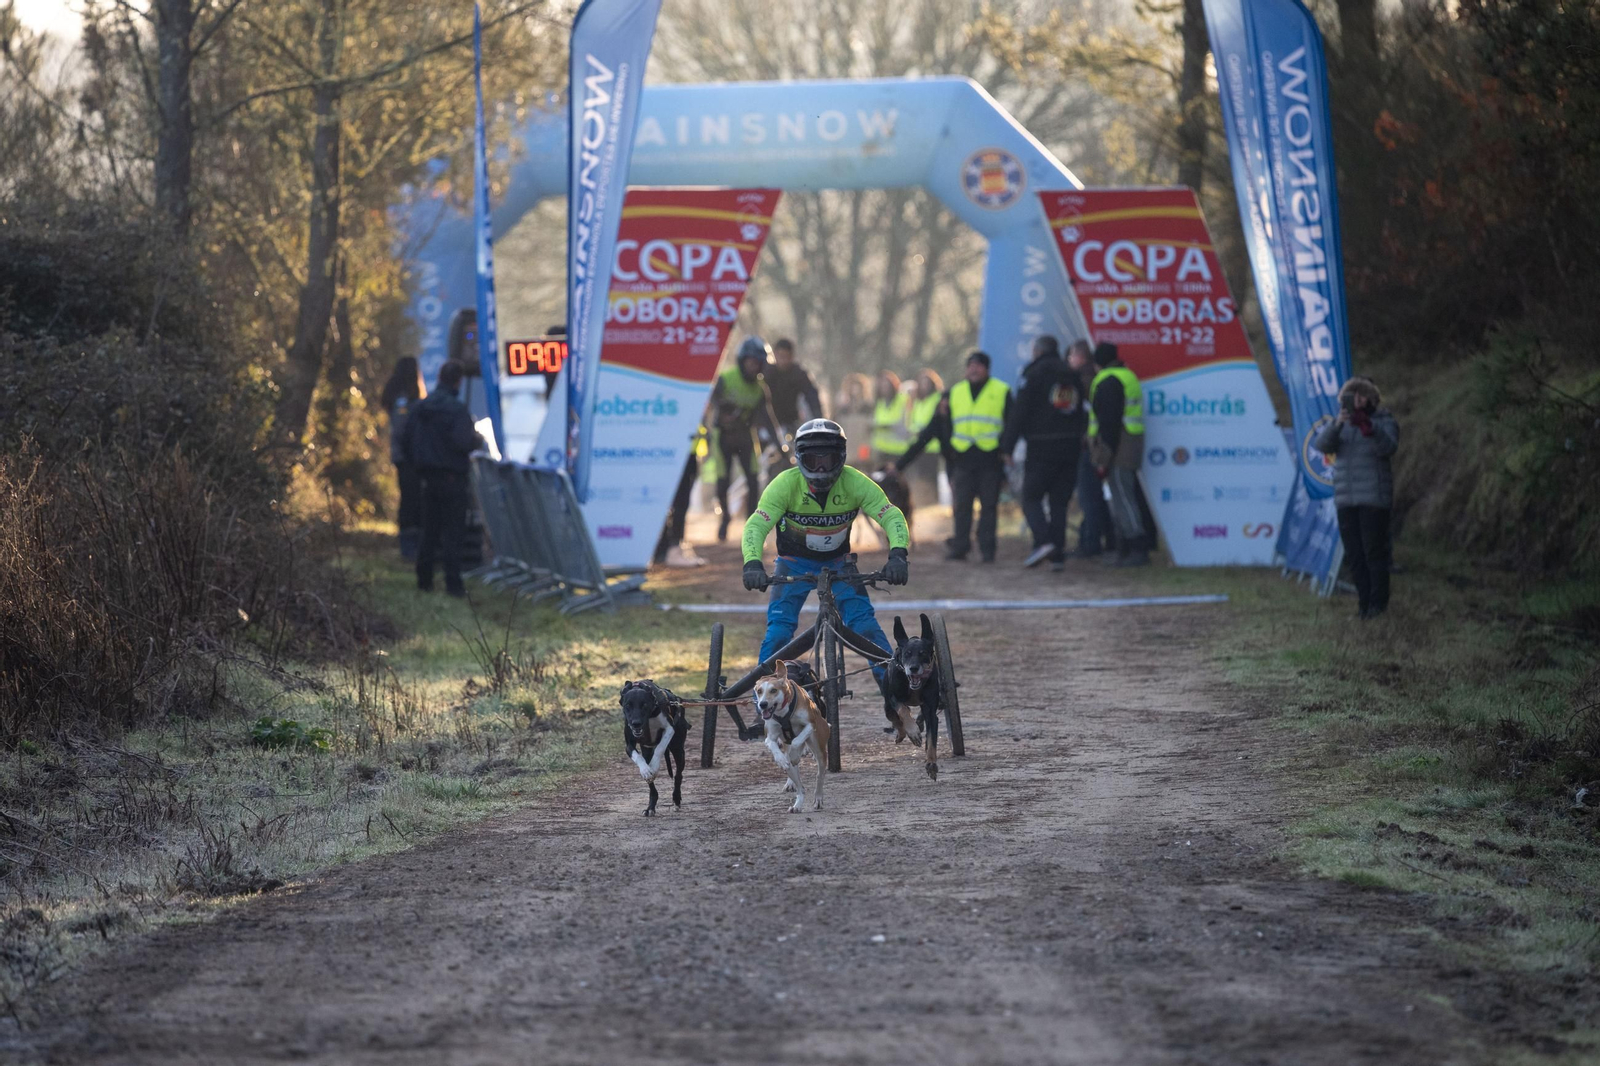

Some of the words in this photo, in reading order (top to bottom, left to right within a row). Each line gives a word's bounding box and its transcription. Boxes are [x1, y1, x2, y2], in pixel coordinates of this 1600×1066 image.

[610, 62, 631, 122] INVIERNO
[611, 239, 748, 280] COPA
[1073, 240, 1213, 281] COPA
[662, 326, 719, 344] 21-22
[1160, 326, 1215, 344] 21-22
[509, 341, 568, 374] 090
[824, 535, 833, 545] 2
